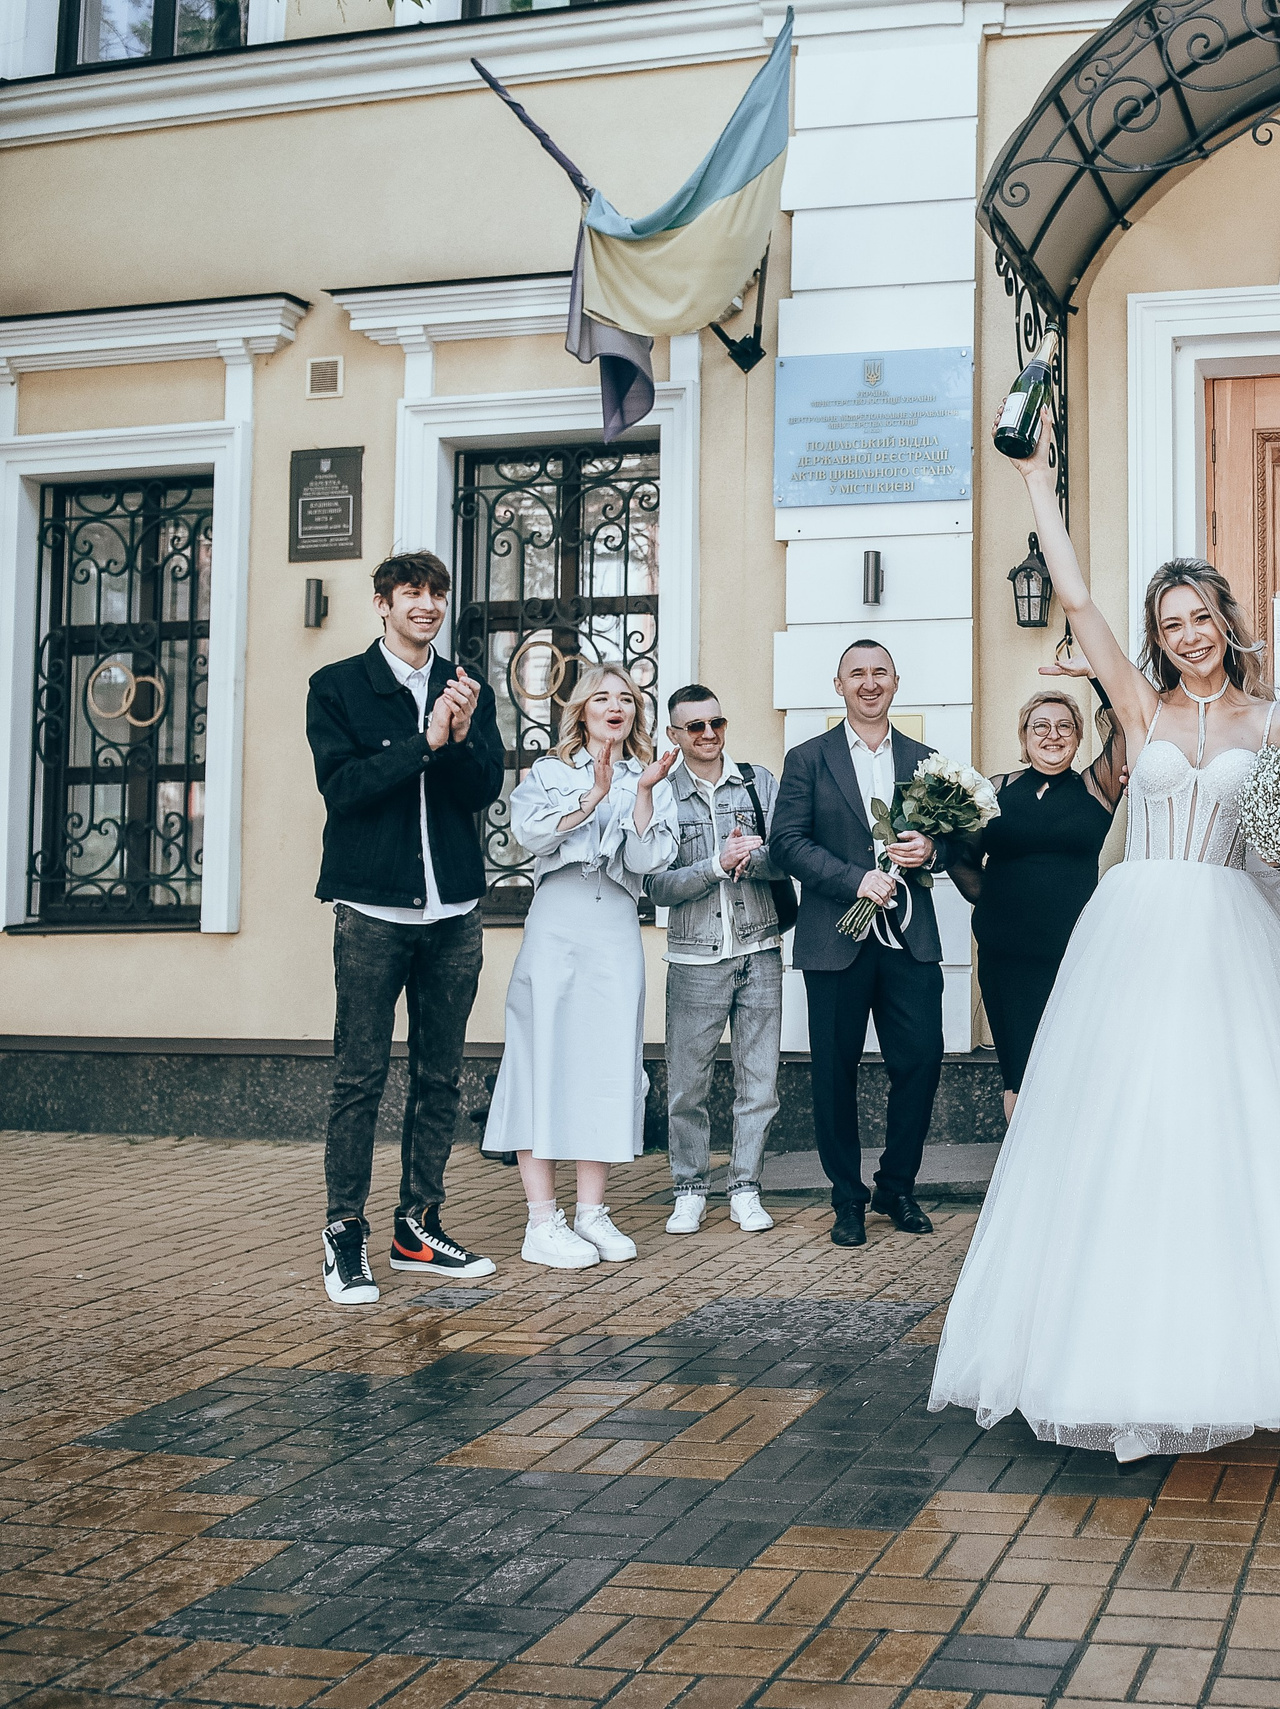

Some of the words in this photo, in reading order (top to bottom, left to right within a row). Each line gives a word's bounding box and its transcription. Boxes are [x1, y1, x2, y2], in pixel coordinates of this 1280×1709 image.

[806, 435, 896, 452] ПОДІЛЬСЬКИЙ
[898, 436, 939, 449] ВІДДІЛ
[797, 452, 872, 468] ДЕРЖАВНОЇ
[874, 448, 949, 464] РЕЄСТРАЦІЇ
[790, 470, 826, 482] АКТІВ
[829, 467, 910, 482] ЦИВІЛЬНОГО
[912, 464, 955, 477] СТАНУ
[829, 484, 837, 495] У
[839, 483, 875, 494] МІСТІ
[876, 481, 915, 493] КИЄВІ
